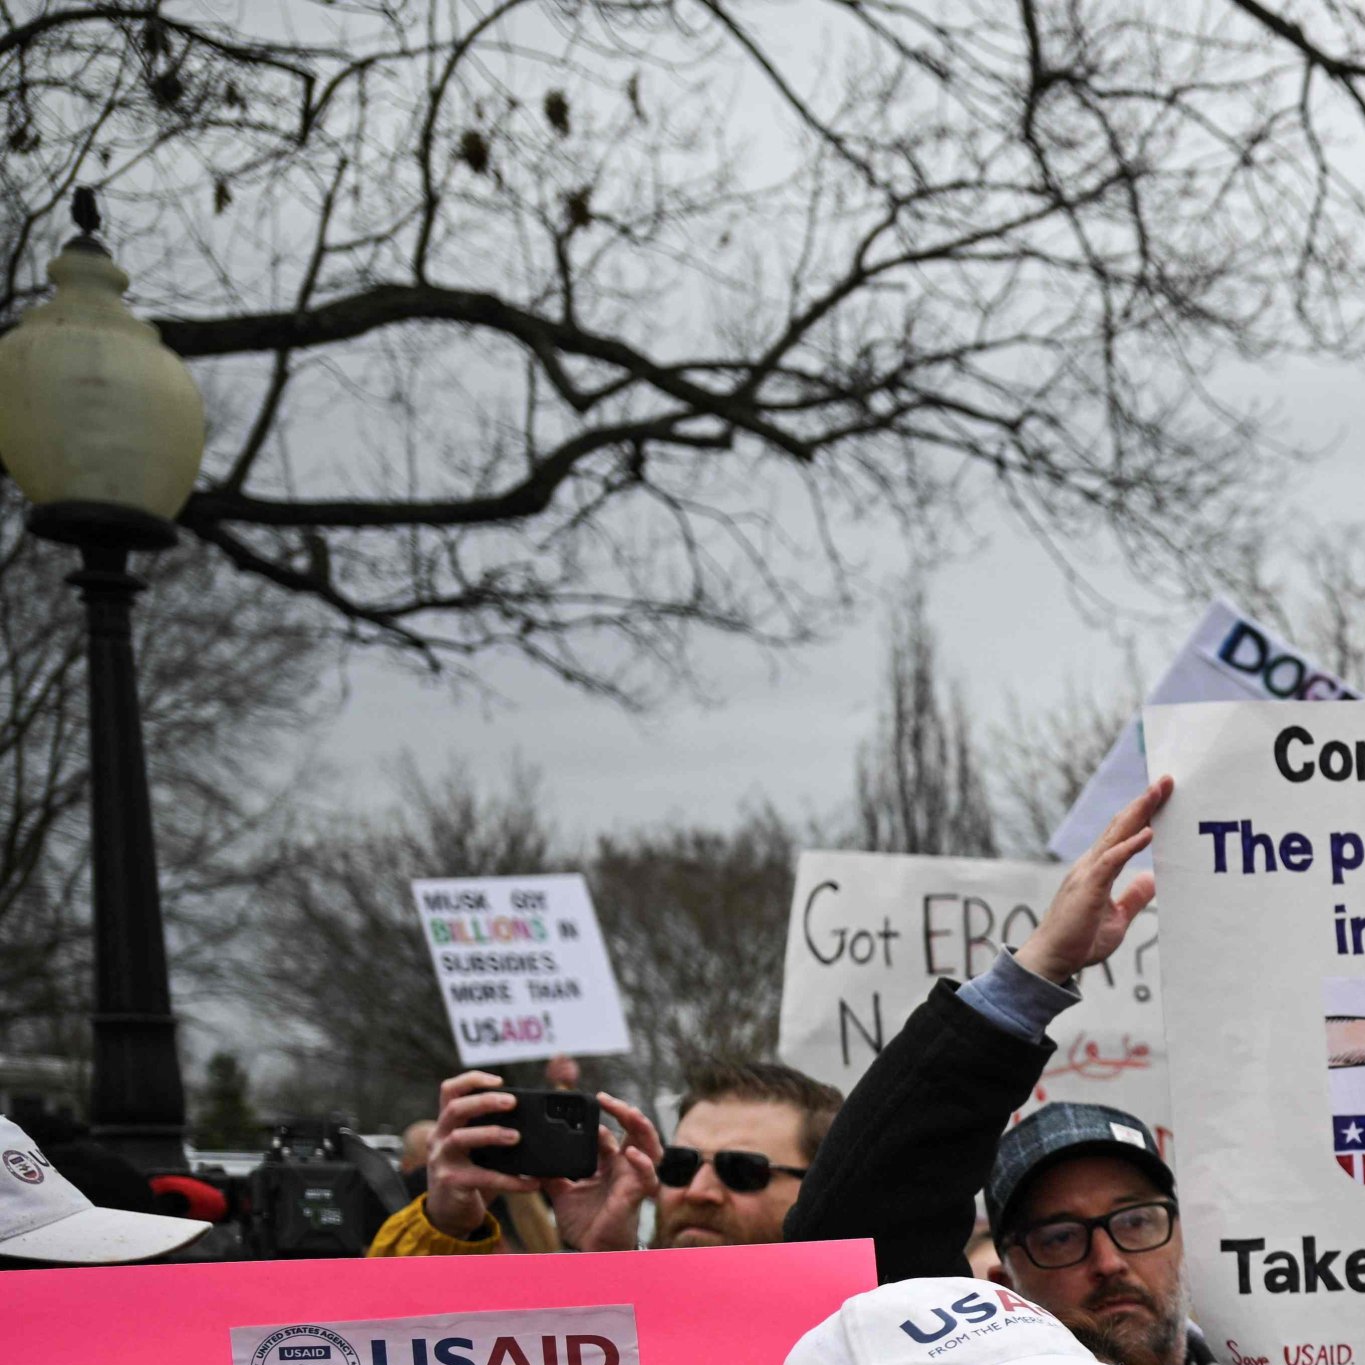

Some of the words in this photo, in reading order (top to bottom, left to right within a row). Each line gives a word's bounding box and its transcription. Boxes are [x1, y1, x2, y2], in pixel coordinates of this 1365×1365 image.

[1199, 820, 1313, 873] The
[430, 916, 547, 943] BILLIONS
[803, 880, 899, 967] Got
[442, 952, 557, 972] SUBSIDIES
[451, 980, 512, 1001] MORE
[527, 979, 582, 1000] THAN
[461, 1011, 554, 1044] USAID!
[256, 1333, 284, 1359] UNITED
[285, 1327, 320, 1336] STATES
[320, 1330, 354, 1356] AGENCY
[284, 1348, 325, 1358] USAID
[928, 1333, 969, 1359] FROM
[972, 1321, 1004, 1340] THE
